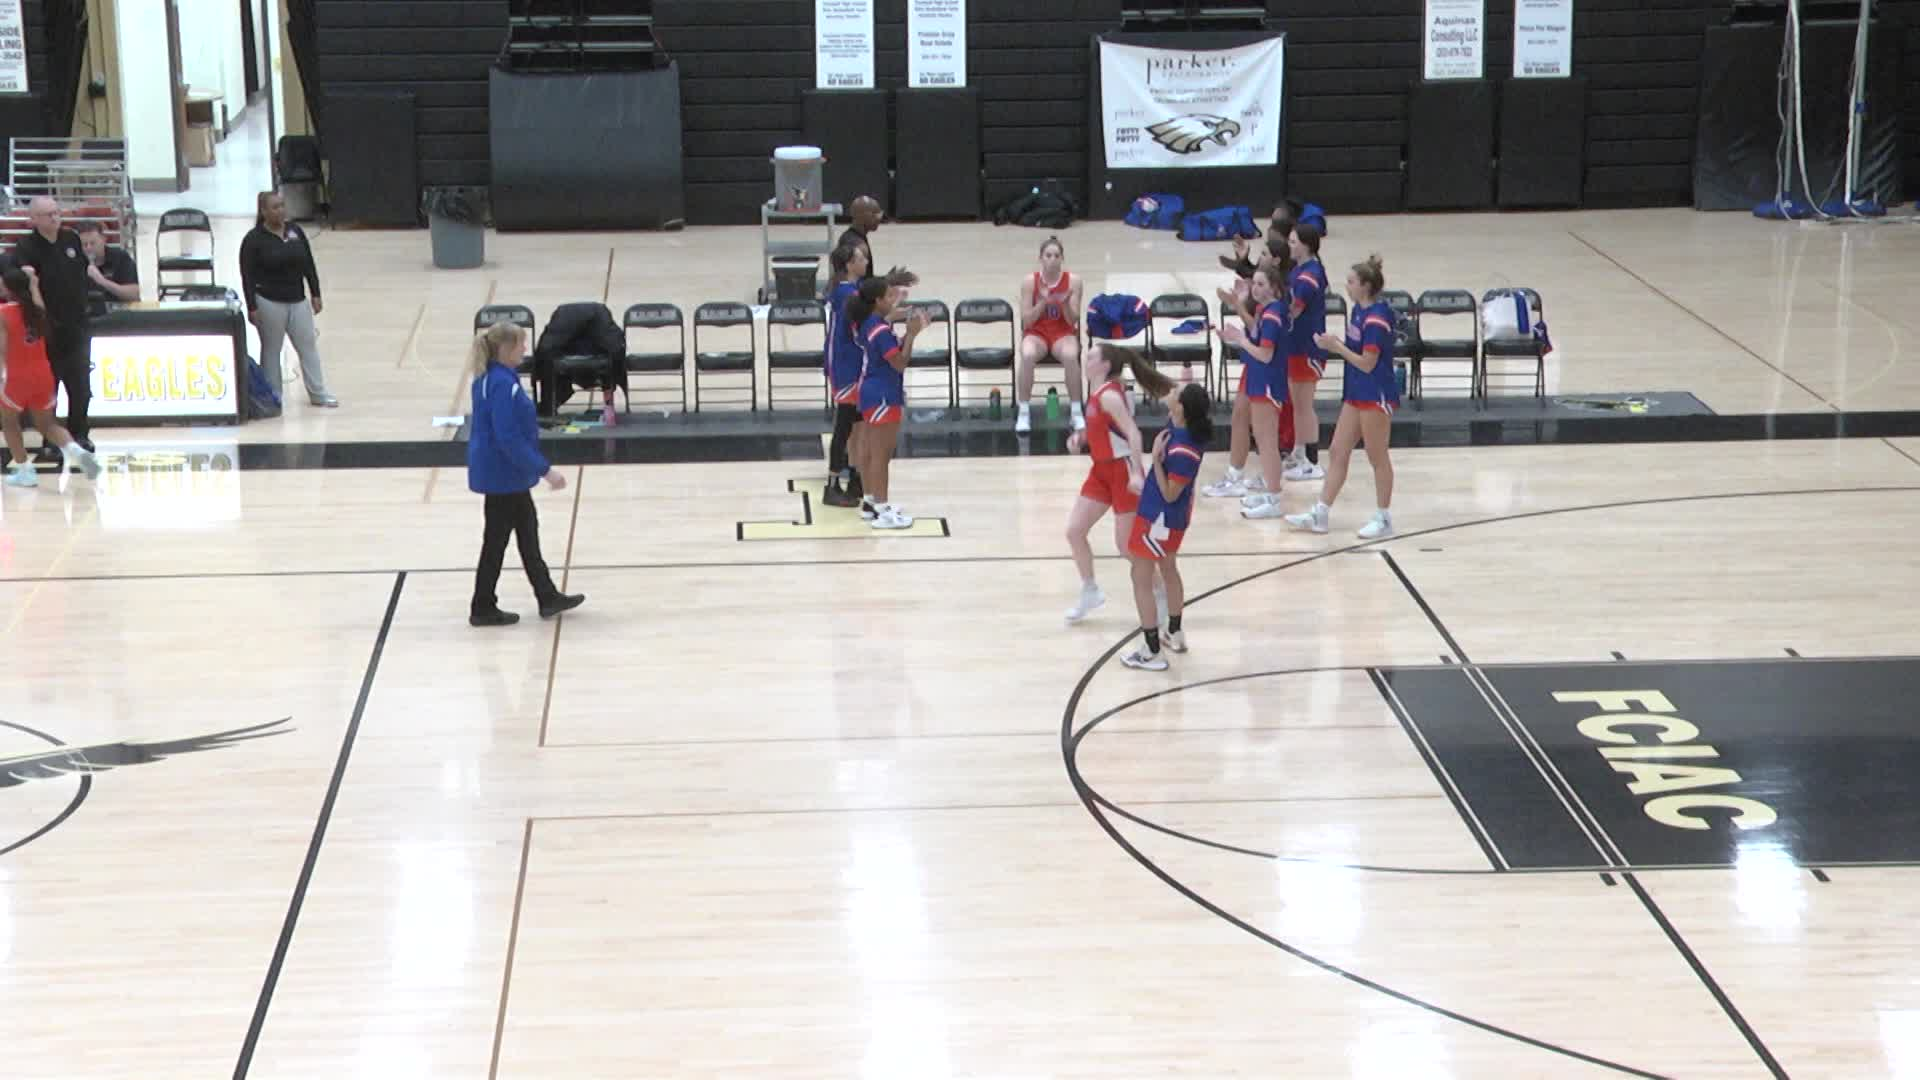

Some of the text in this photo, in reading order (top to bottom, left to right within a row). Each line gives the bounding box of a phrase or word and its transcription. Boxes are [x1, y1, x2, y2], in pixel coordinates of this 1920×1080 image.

[1434, 16, 1476, 27] Aquinas
[101, 354, 227, 401] EAGLES
[1551, 689, 1778, 831] FCIAC
